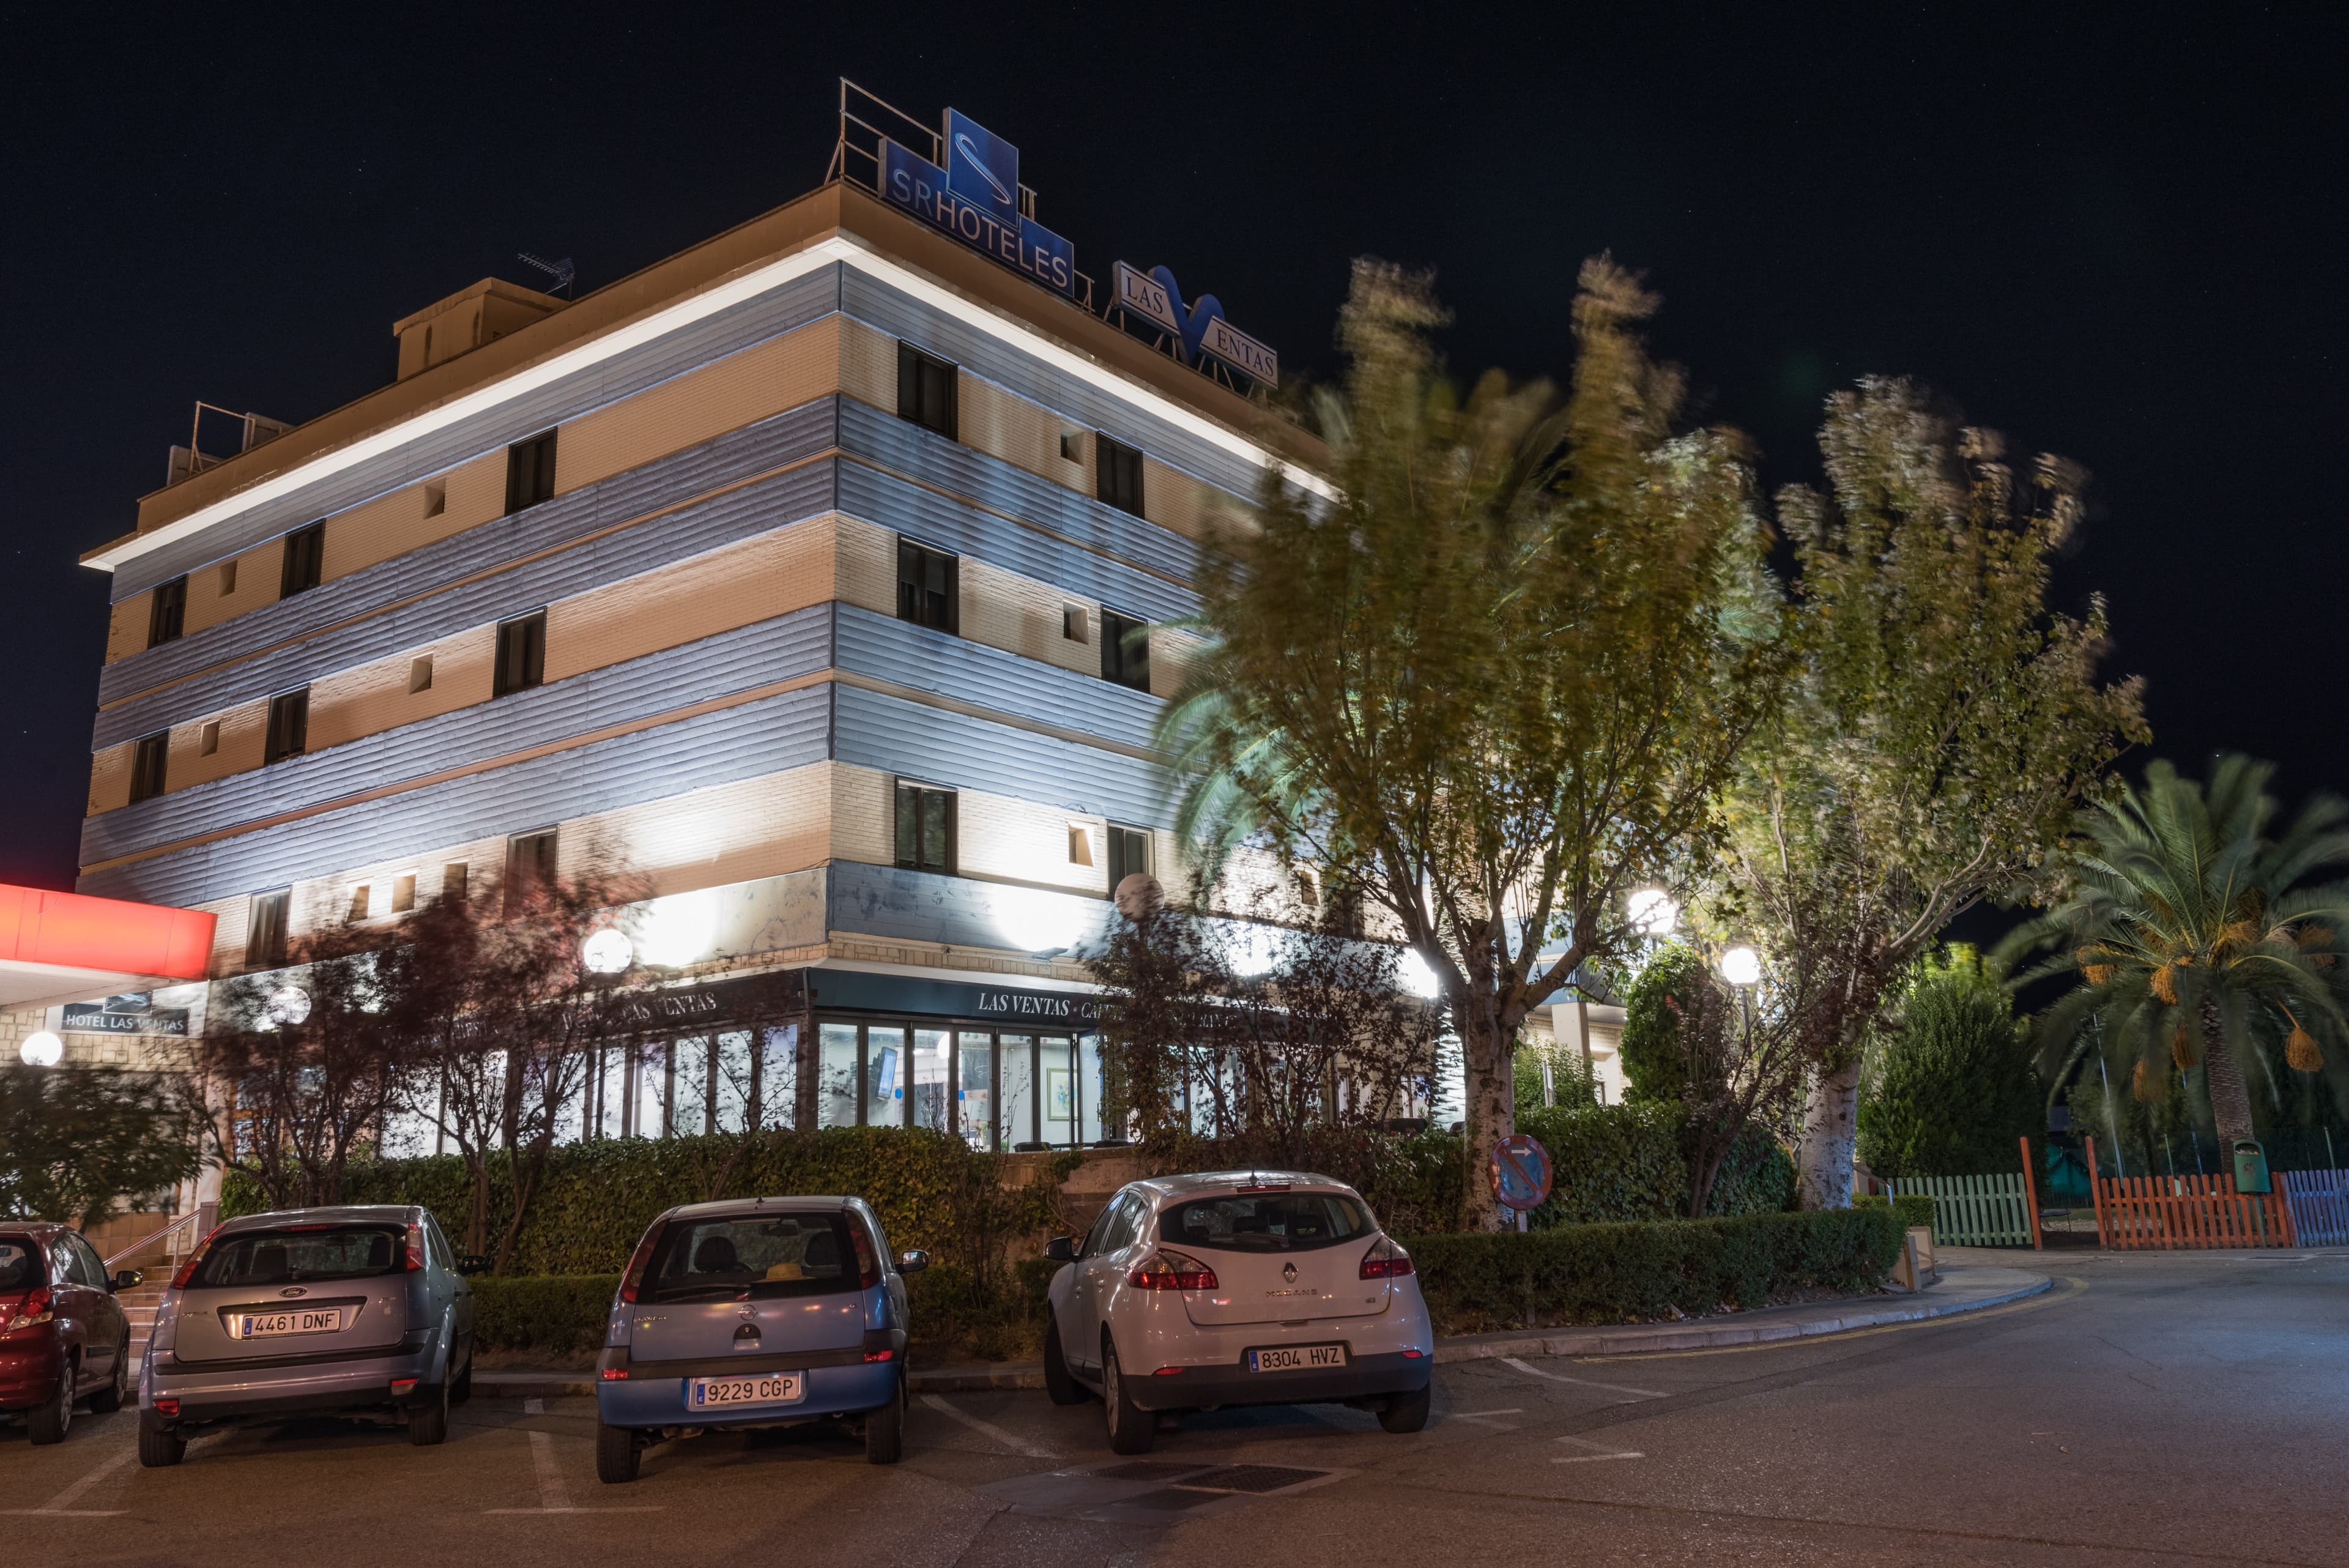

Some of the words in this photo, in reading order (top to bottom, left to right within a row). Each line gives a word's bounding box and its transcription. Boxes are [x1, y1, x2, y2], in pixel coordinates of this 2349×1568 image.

[1126, 275, 1163, 314] LAS
[652, 991, 718, 1017] ENTAS
[978, 992, 1009, 1012] LAS
[1012, 995, 1071, 1017] VENTAS
[66, 1014, 107, 1028] HOTEL
[110, 1017, 133, 1029] LAS
[136, 1018, 184, 1031] VENTAS
[254, 1315, 295, 1332] 4461
[303, 1313, 335, 1329] DNF
[1261, 1350, 1302, 1369] 8304
[1310, 1347, 1340, 1365] HVZ
[708, 1382, 754, 1402] 9229
[760, 1379, 793, 1398] CGP
